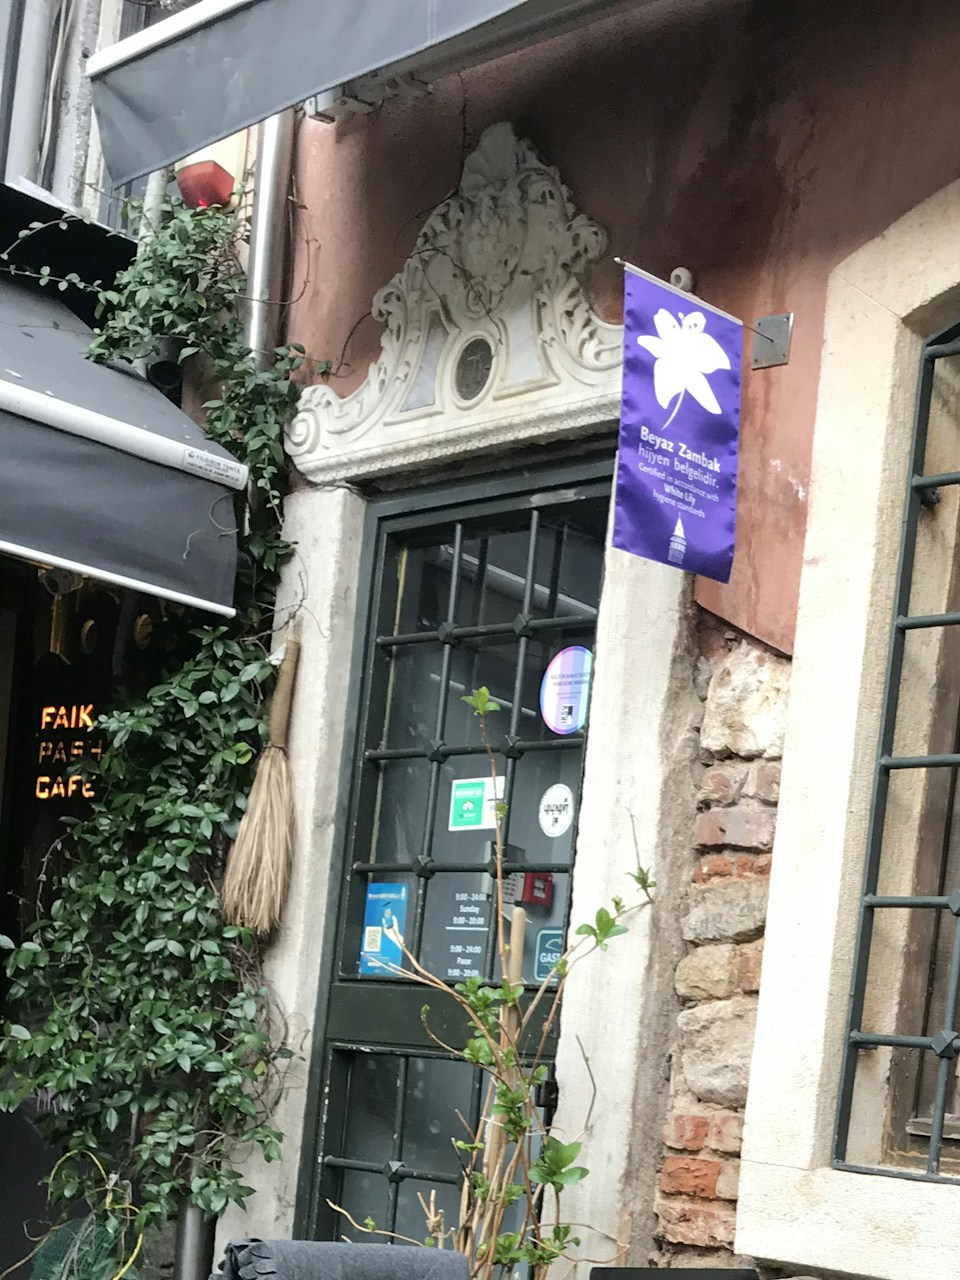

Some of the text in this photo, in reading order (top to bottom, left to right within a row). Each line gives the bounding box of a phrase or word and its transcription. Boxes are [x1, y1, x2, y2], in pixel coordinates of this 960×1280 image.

[638, 442, 719, 488] hijyen belgelidir.
[640, 425, 721, 473] Beyaz Zambak
[663, 483, 696, 507] White Lily
[459, 904, 480, 914] Sunday
